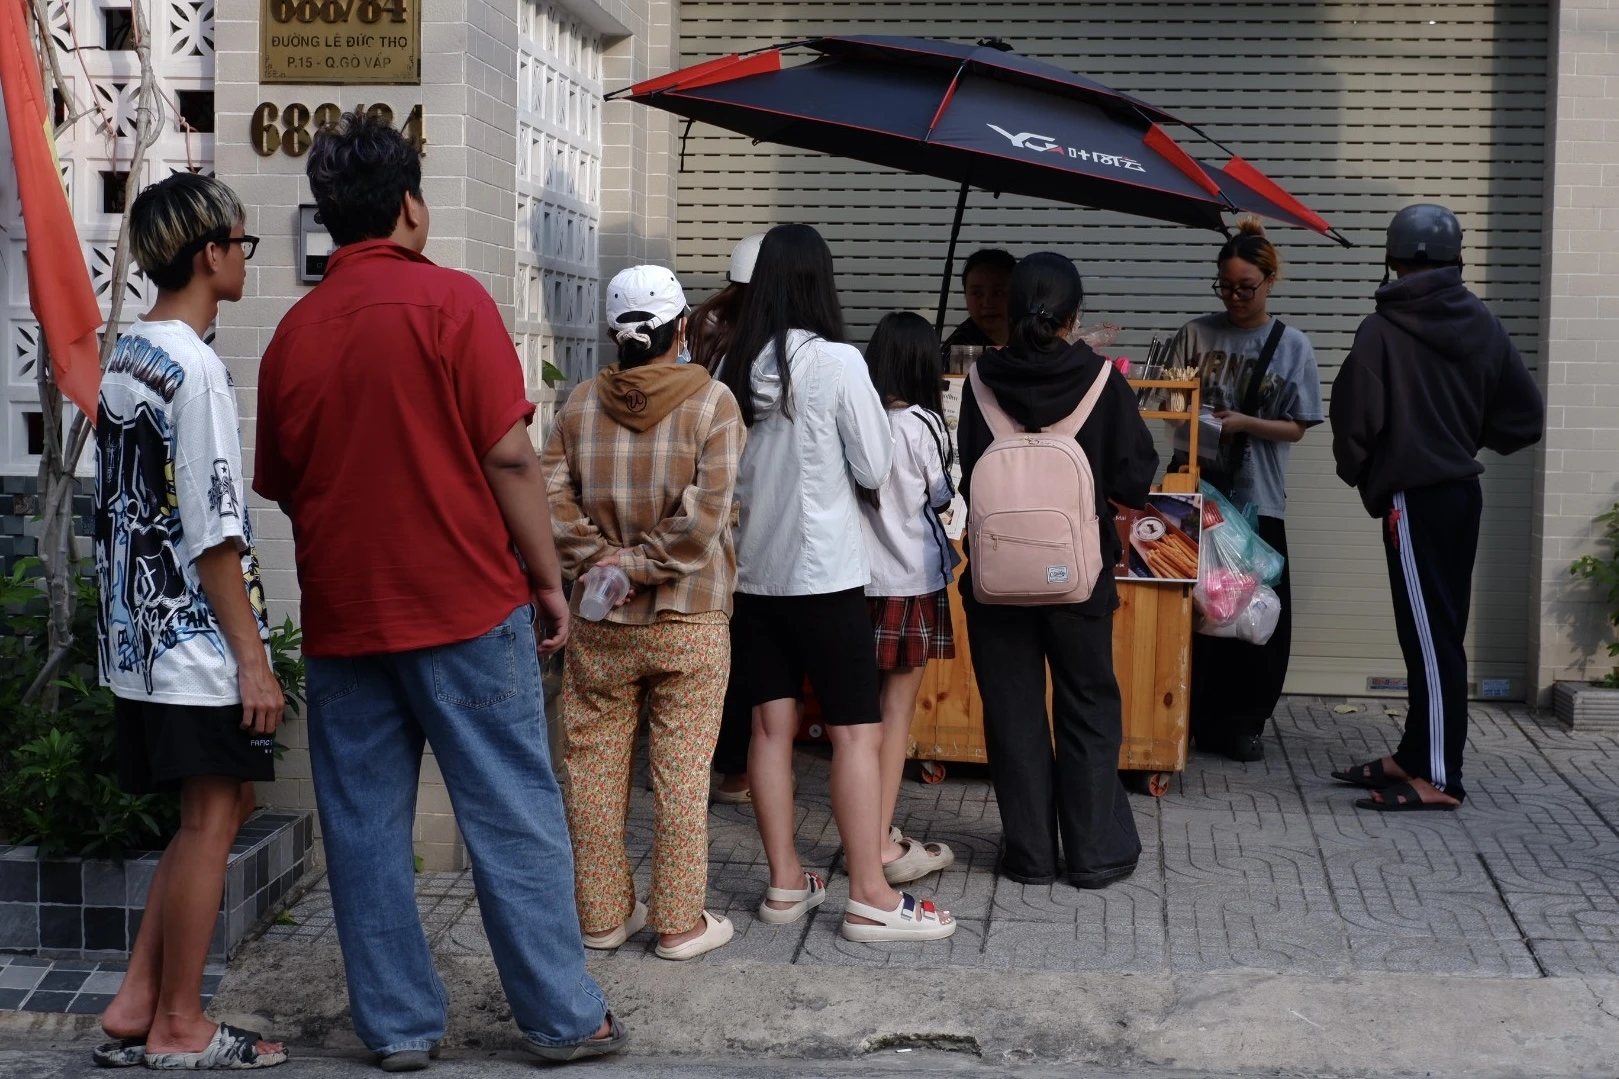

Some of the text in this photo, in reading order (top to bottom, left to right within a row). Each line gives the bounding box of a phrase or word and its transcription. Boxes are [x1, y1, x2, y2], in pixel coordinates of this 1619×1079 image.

[271, 32, 408, 50] ĐƯỜNG LÊ ĐỨC THỌ
[287, 56, 313, 68] P.15
[325, 54, 361, 69] Q.GÒ
[364, 53, 392, 68] VẤP
[250, 102, 427, 157] 6884
